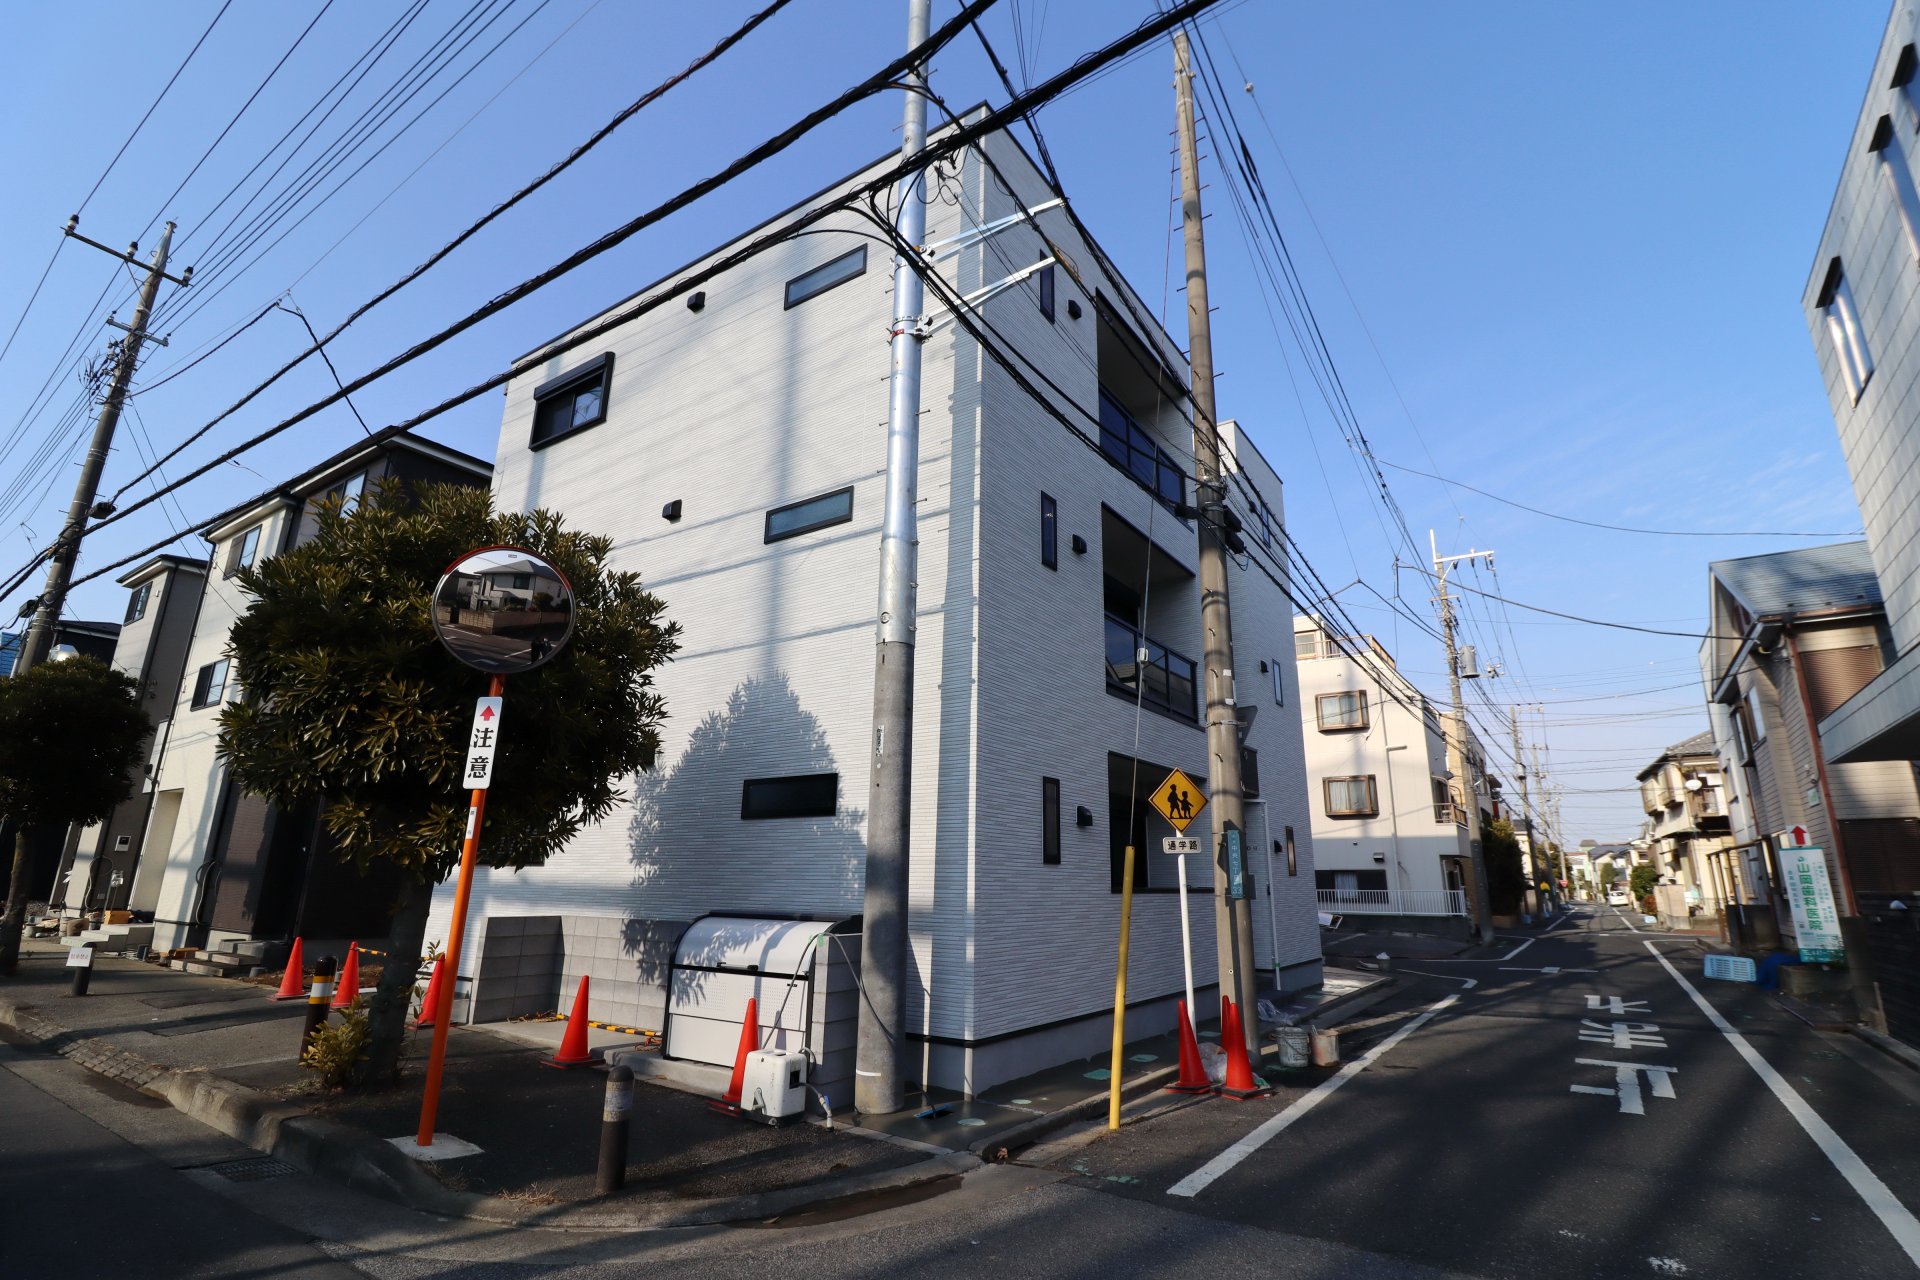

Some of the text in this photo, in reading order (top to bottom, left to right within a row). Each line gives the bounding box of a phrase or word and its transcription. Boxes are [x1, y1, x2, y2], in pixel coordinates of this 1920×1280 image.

[467, 727, 494, 779] 注意
[1167, 840, 1198, 851] 通学路
